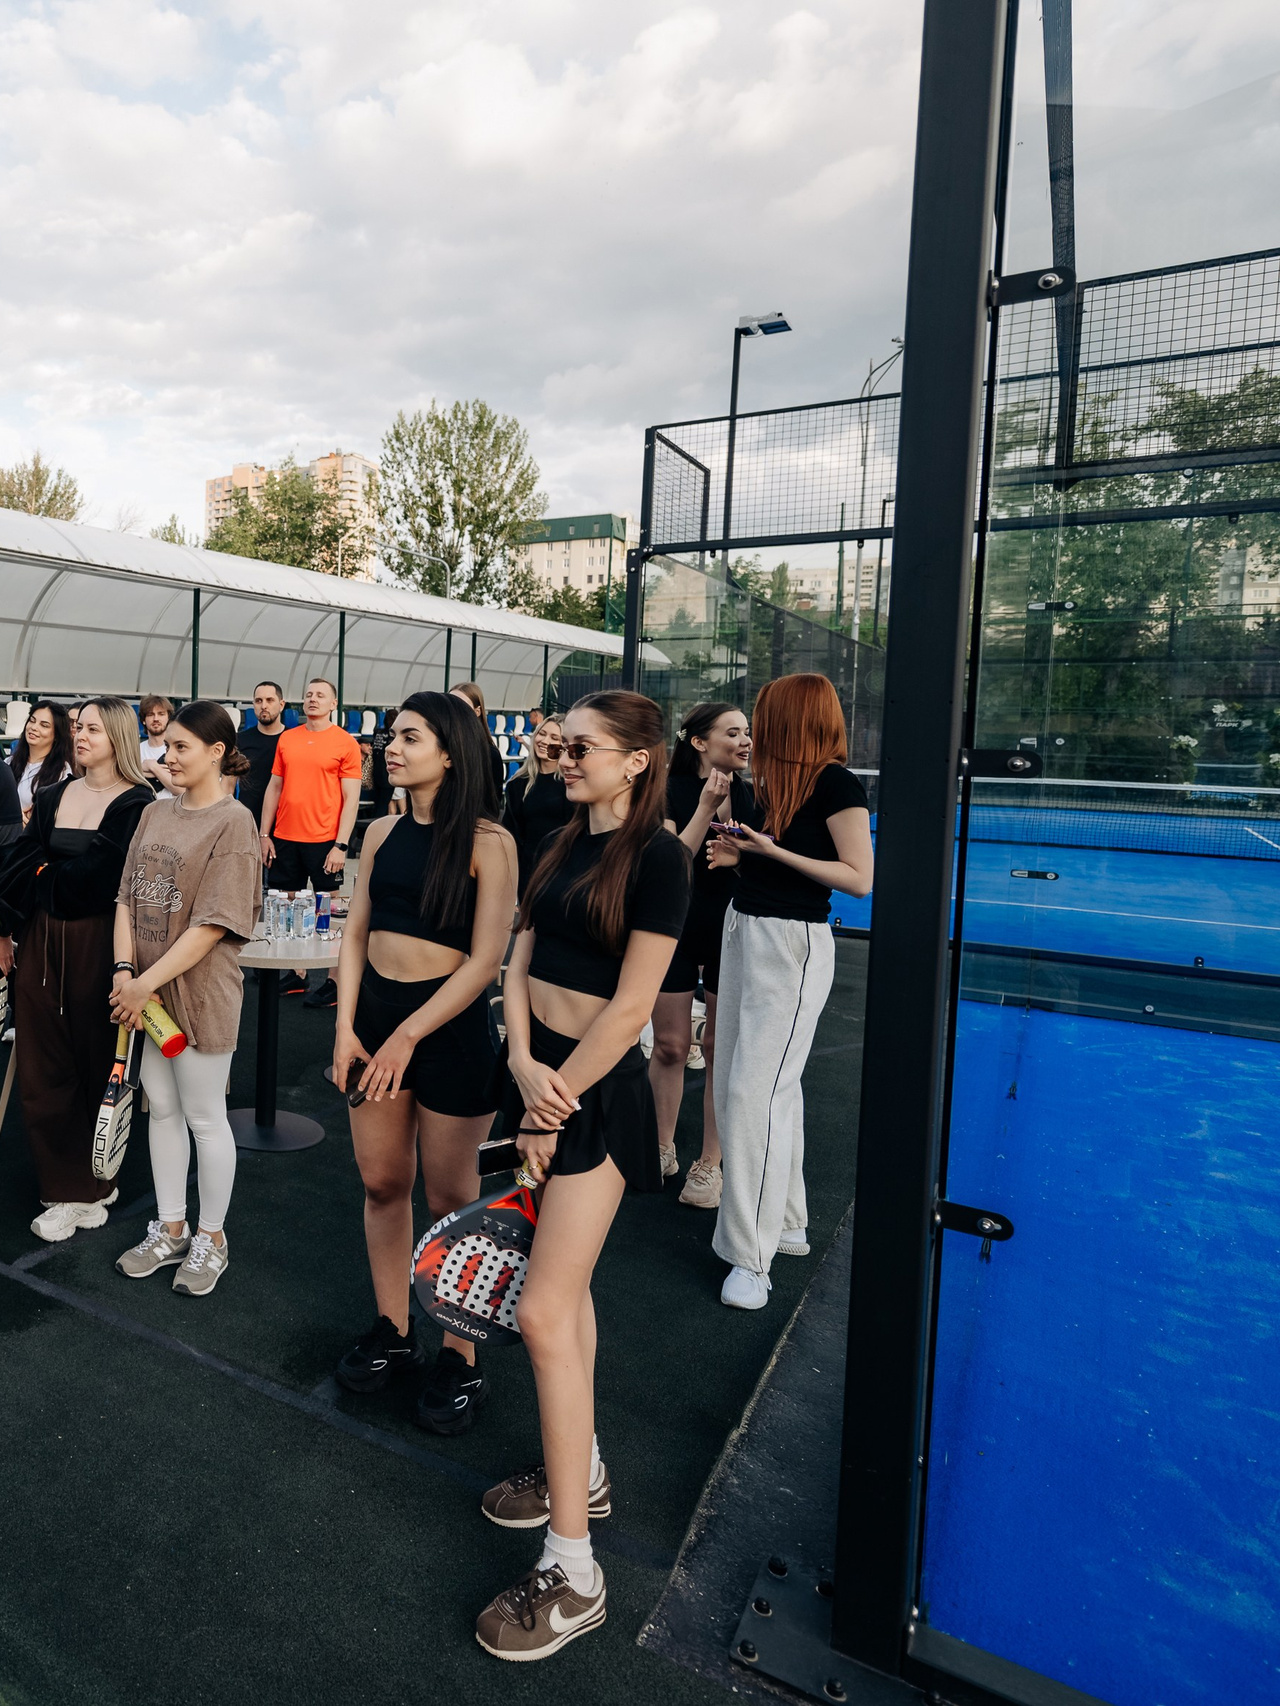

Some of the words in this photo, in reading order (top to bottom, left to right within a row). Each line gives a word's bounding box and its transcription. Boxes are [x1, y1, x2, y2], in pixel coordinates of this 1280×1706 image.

[151, 843, 187, 872] ORIGINAL
[93, 1116, 110, 1178] INDIGA
[451, 1318, 488, 1340] OPTIX
